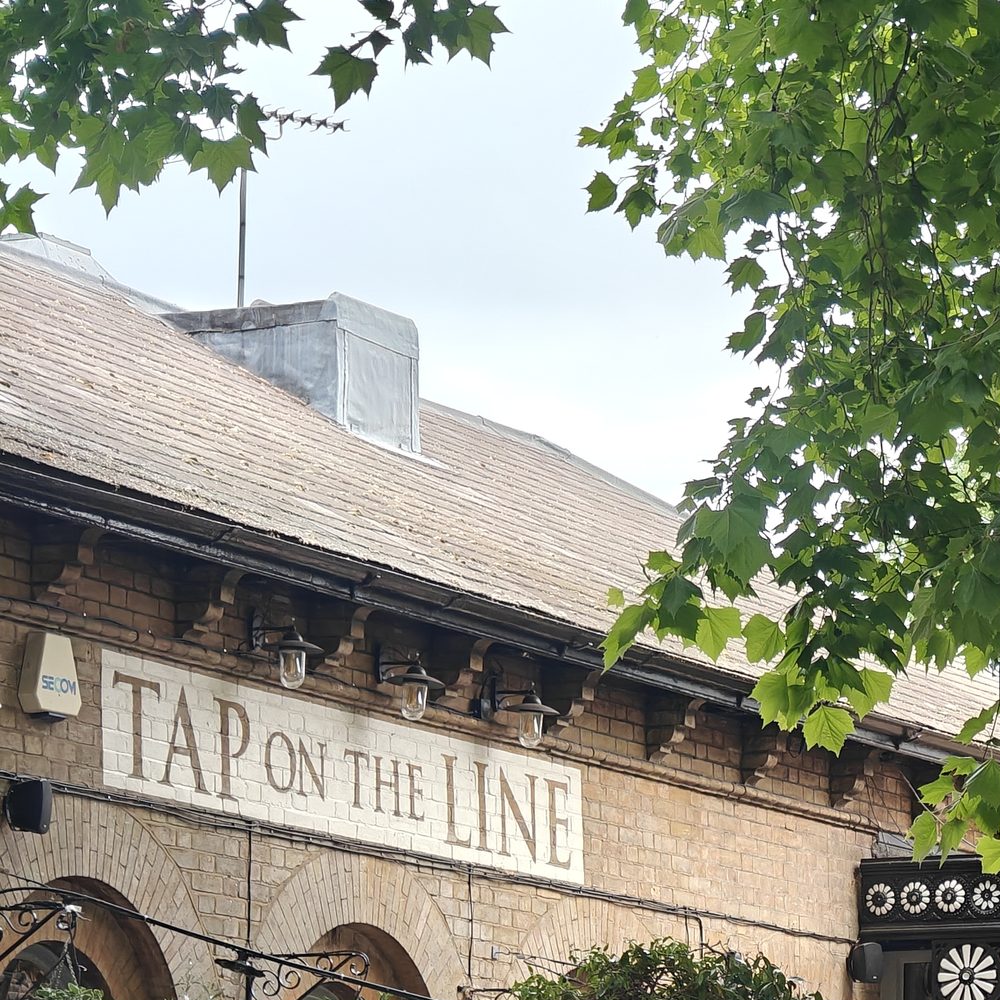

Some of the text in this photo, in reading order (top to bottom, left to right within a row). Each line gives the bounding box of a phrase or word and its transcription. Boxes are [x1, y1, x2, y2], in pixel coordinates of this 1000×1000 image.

[41, 675, 76, 696] SECOM
[112, 670, 571, 870] TAP ON THE LINE
